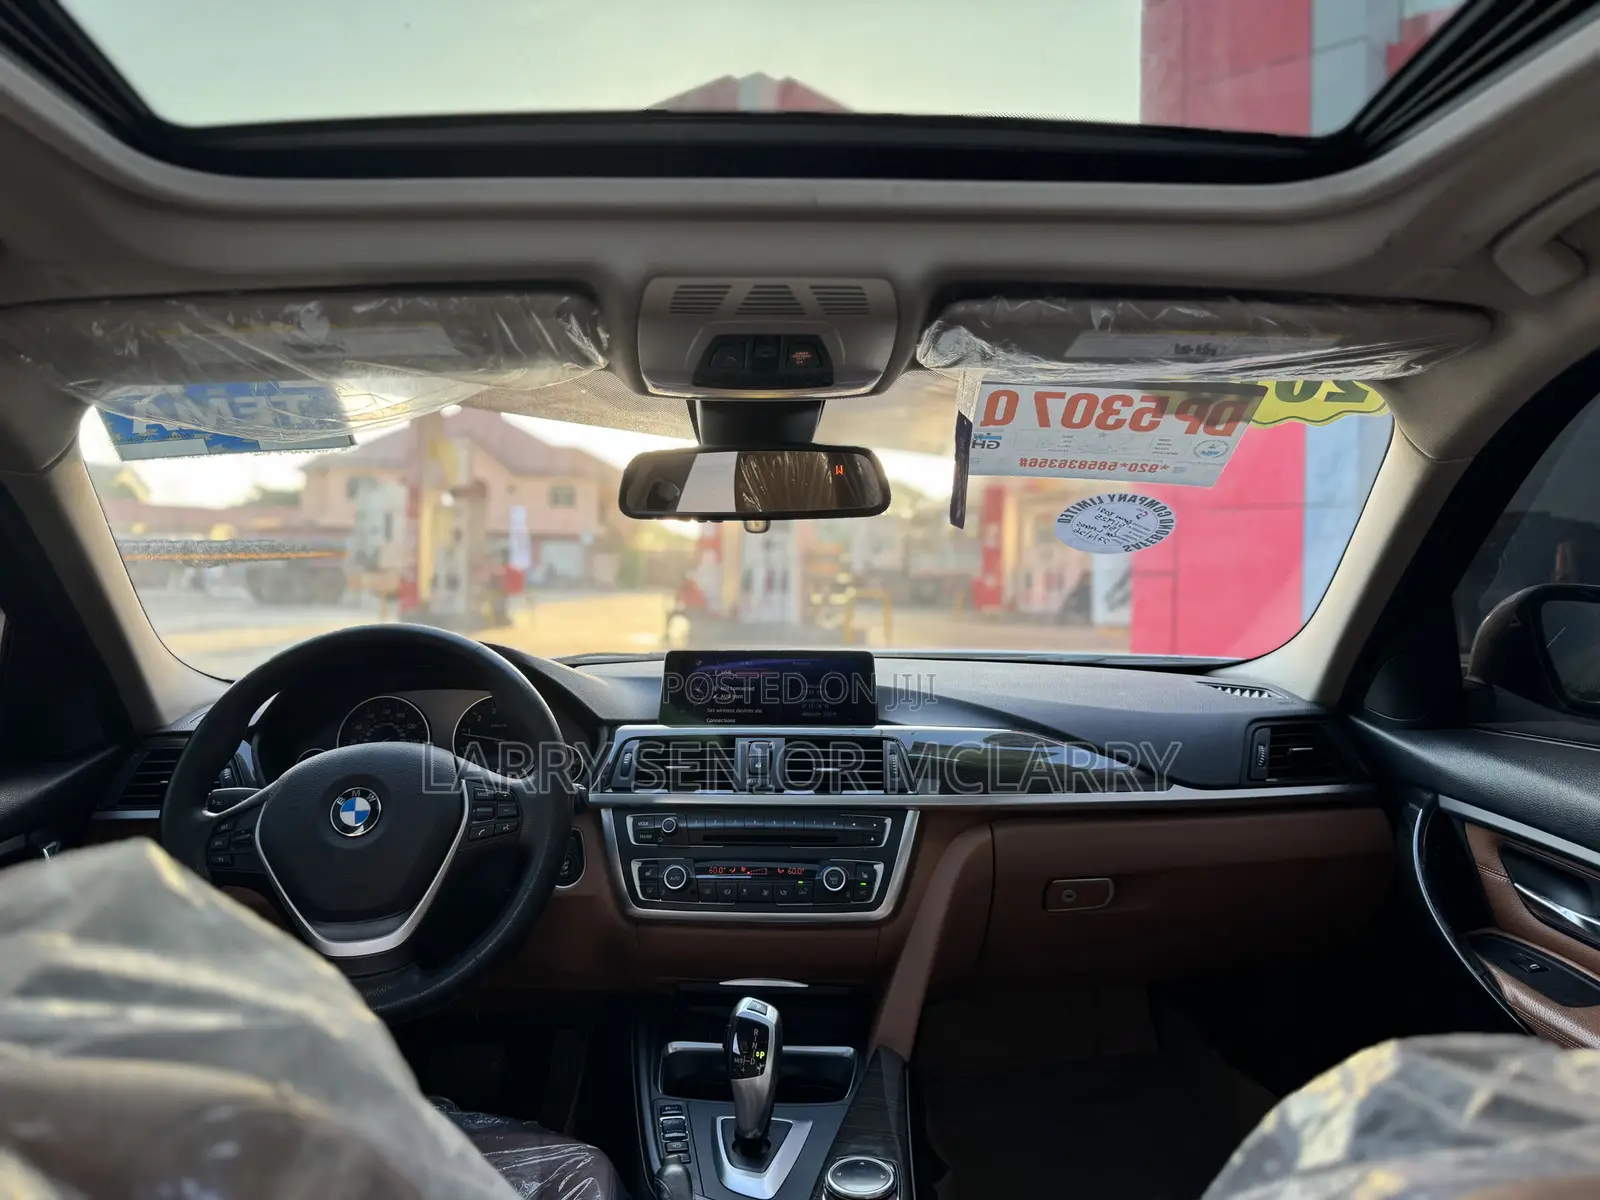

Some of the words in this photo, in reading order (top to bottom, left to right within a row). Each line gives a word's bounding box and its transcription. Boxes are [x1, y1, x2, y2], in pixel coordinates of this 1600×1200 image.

[337, 790, 376, 806] BMW
[753, 1028, 759, 1036] R
[750, 1057, 756, 1065] D
